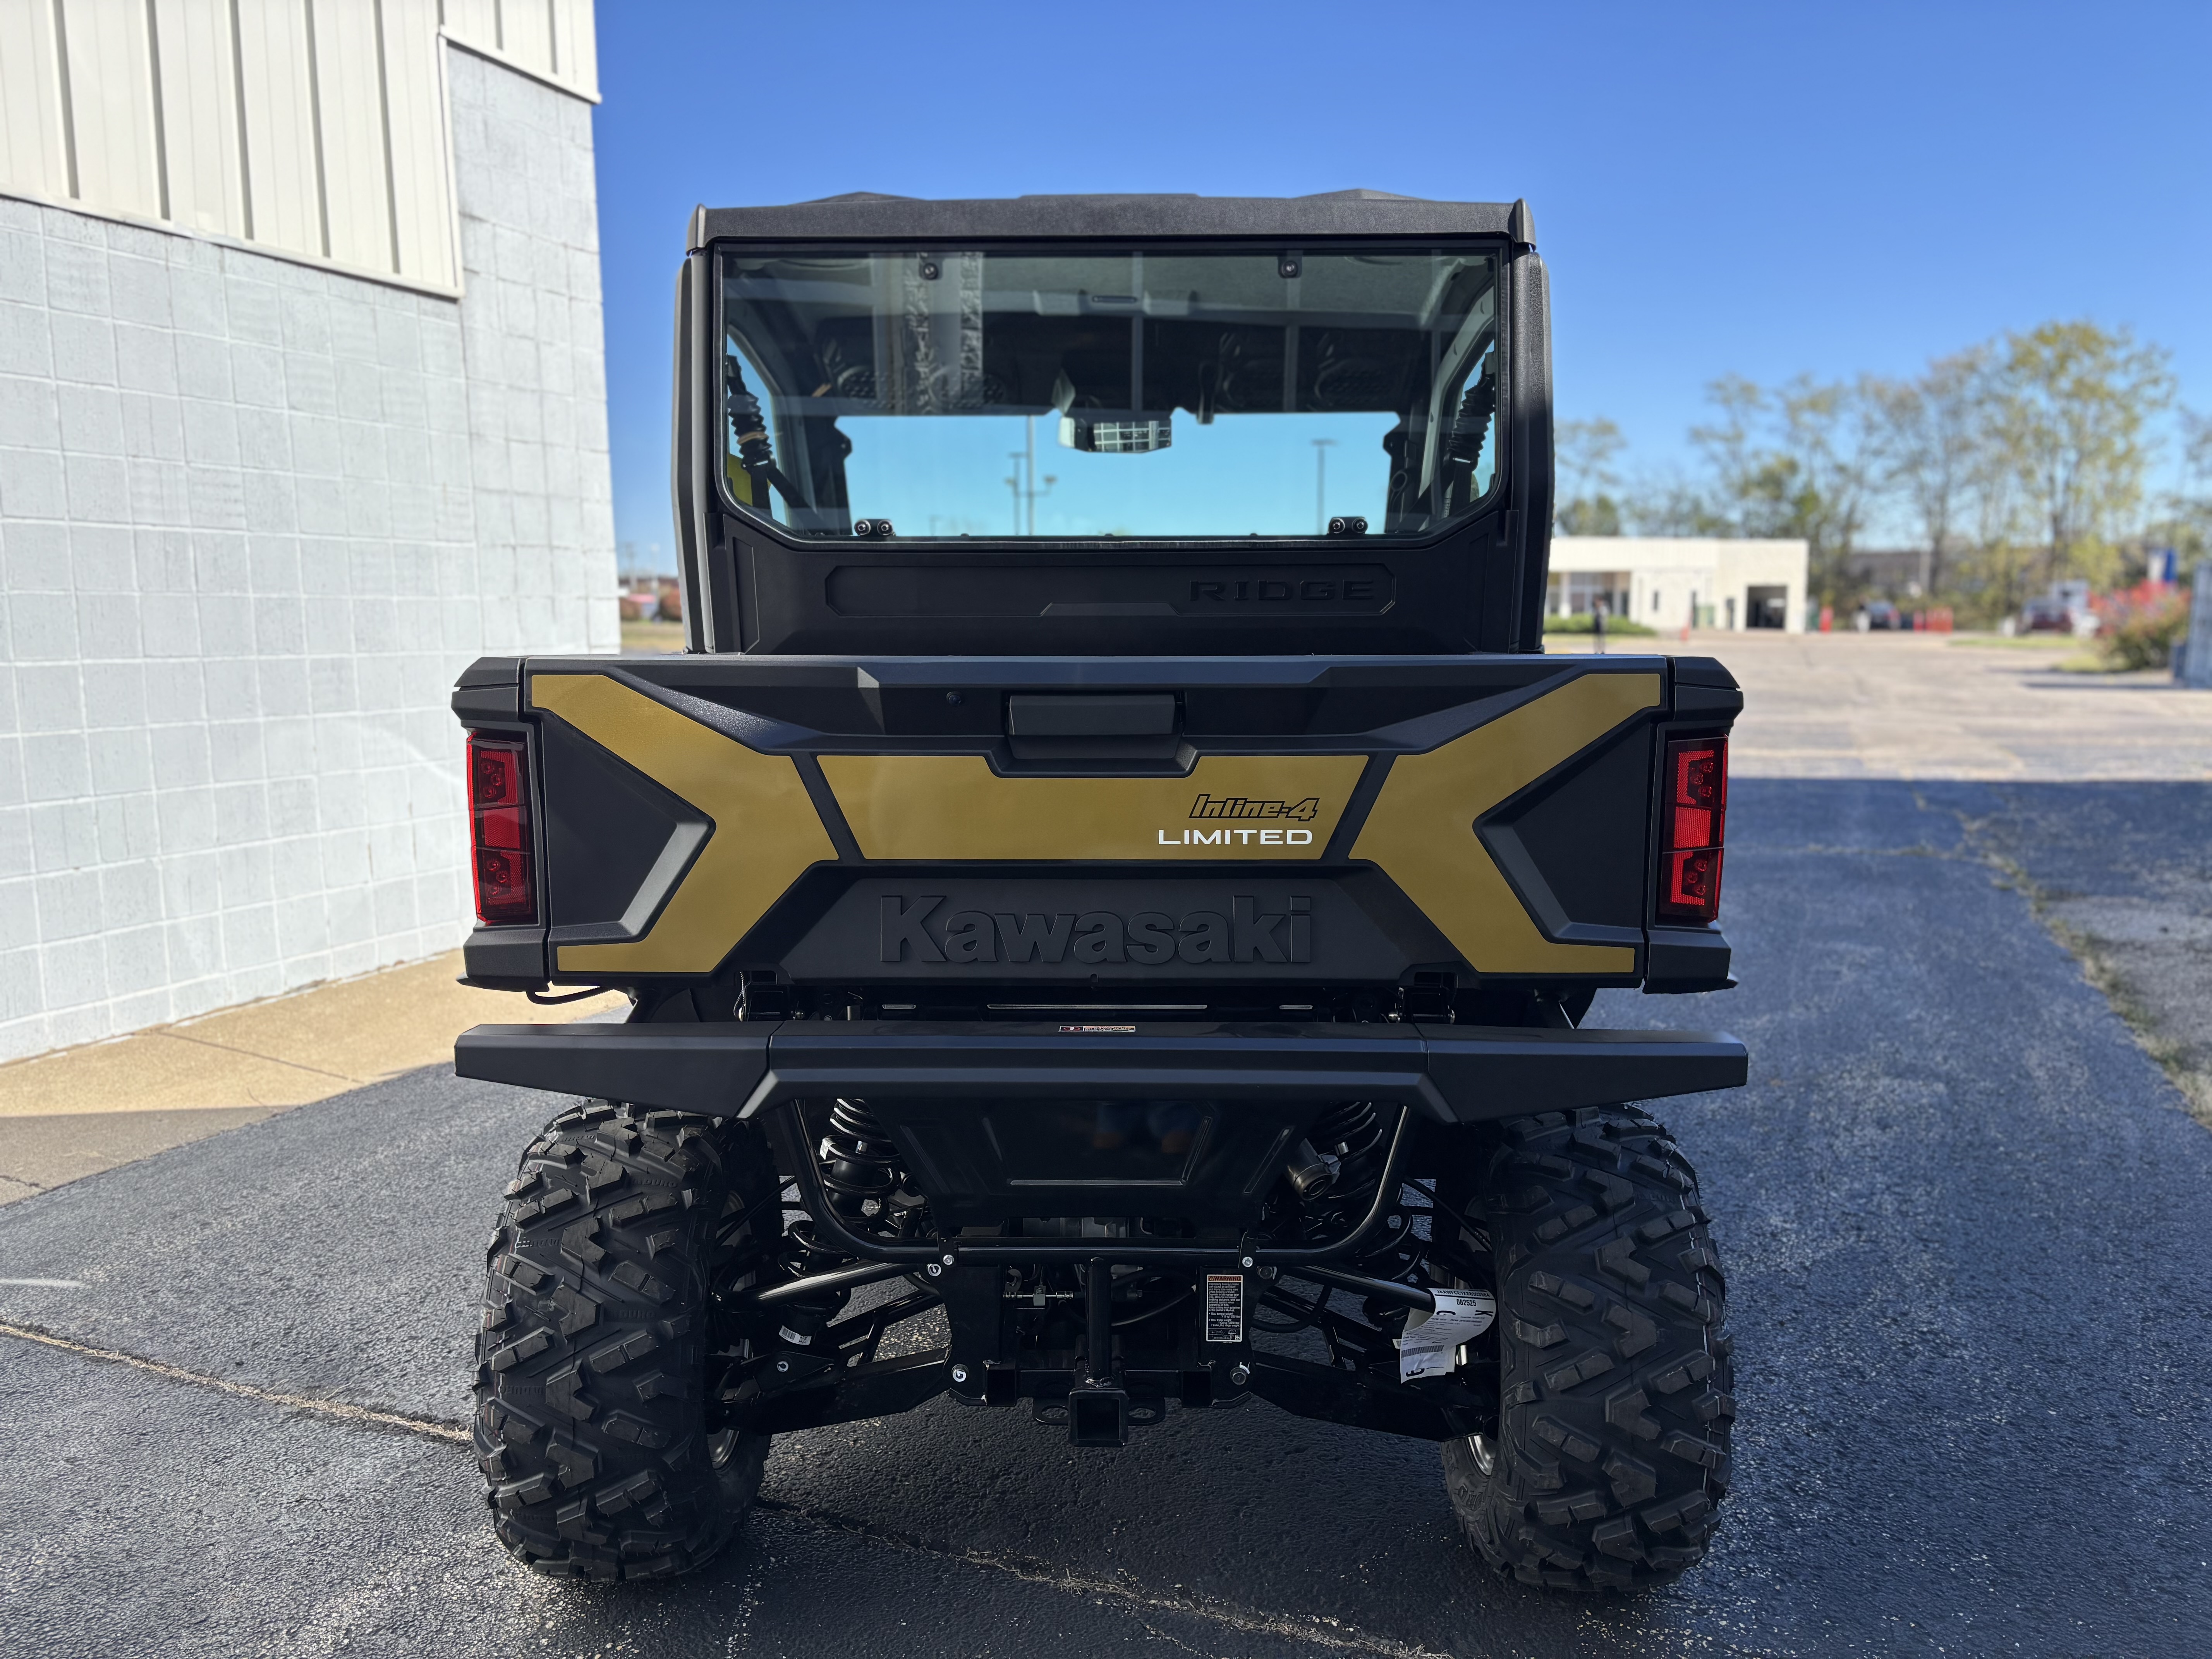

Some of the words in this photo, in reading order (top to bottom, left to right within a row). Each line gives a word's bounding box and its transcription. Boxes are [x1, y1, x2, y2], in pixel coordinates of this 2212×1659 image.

[1190, 580, 1374, 601] RIDGE
[1188, 794, 1320, 821] Inline-4
[1158, 830, 1313, 845] LIMITED
[880, 895, 1312, 964] Kawasaki
